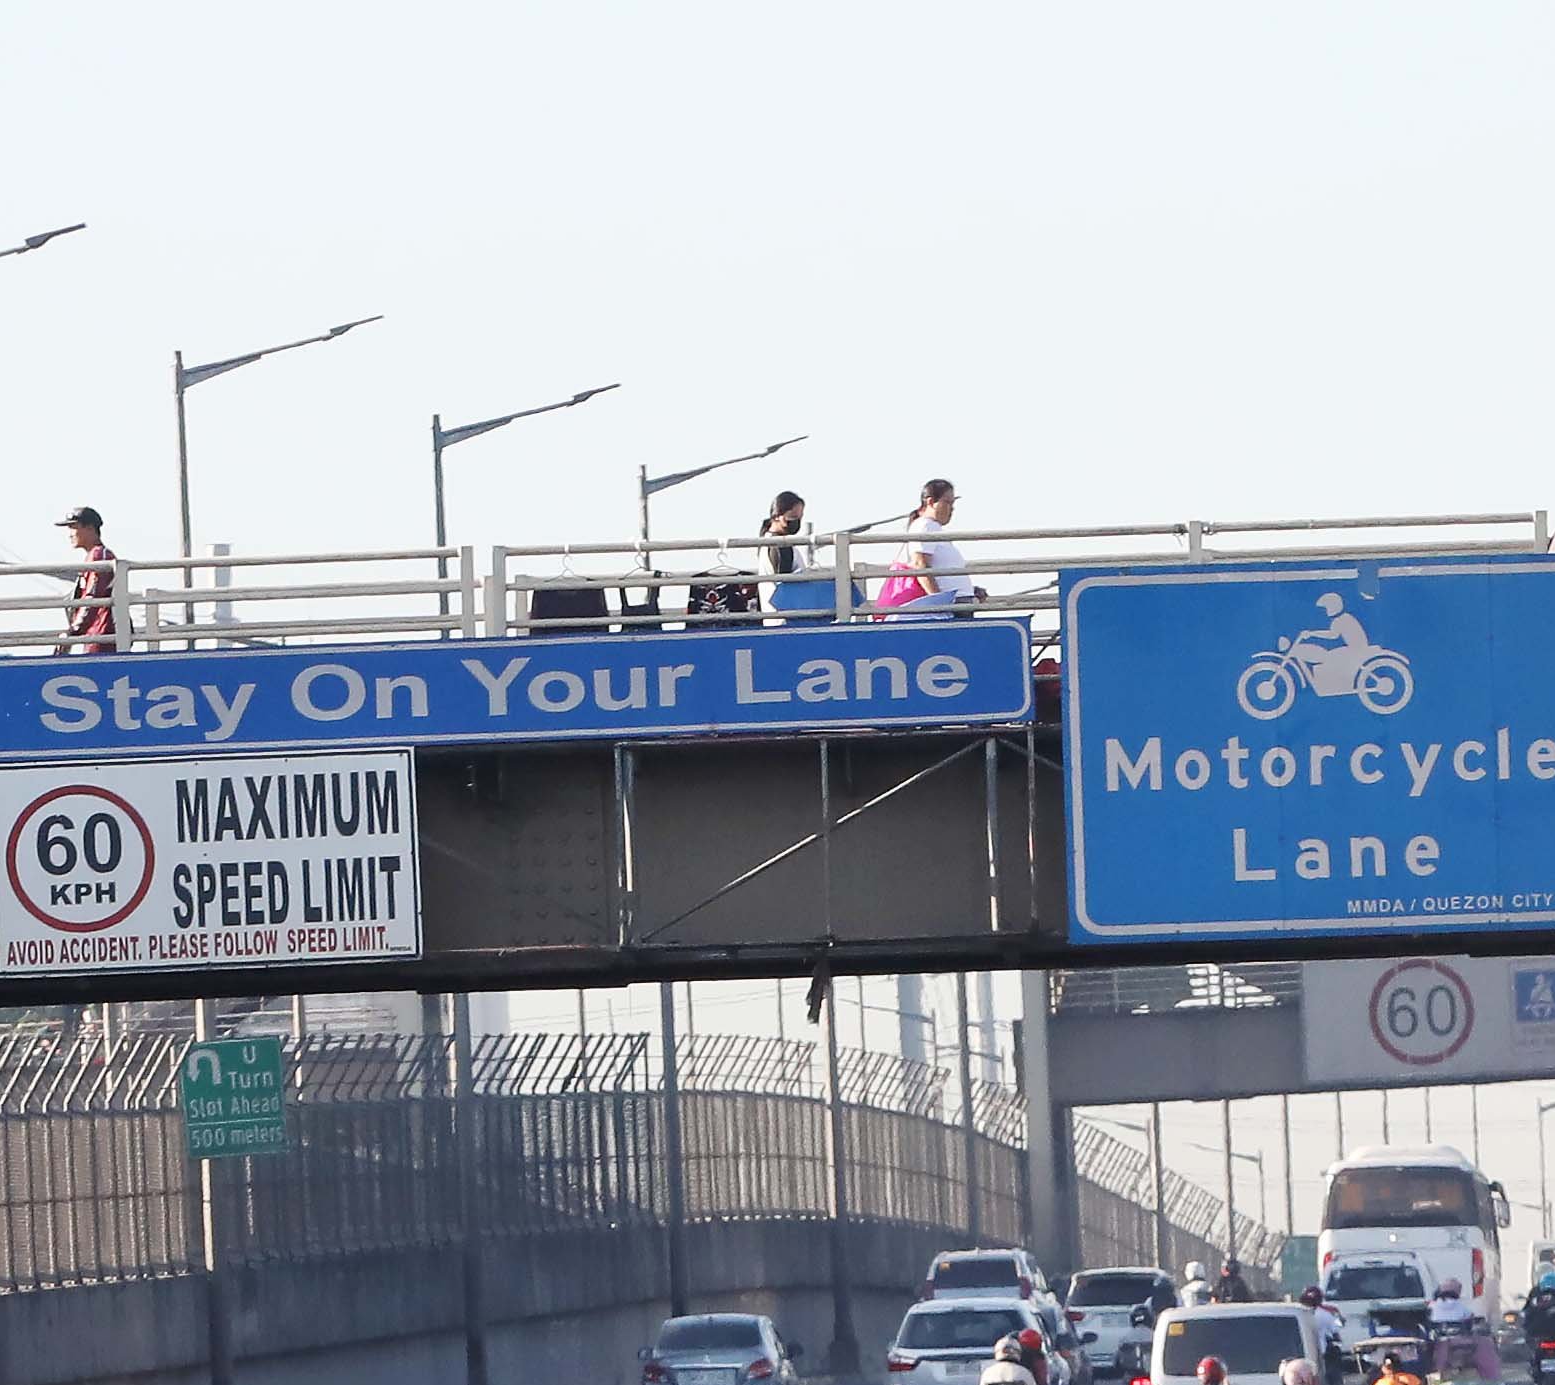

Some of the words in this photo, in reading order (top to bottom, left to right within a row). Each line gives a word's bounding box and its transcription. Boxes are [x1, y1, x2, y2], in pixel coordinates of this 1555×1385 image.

[40, 674, 254, 744] Stay
[292, 663, 427, 722] On
[461, 655, 694, 718] Your
[736, 646, 971, 705] Lane
[176, 769, 400, 843] MAXIMUM
[36, 811, 123, 876] 60
[1233, 829, 1441, 882] Lane
[50, 882, 117, 906] KPH
[173, 861, 289, 929] SPEED
[302, 855, 401, 923] LIMIT
[1347, 899, 1405, 914] MMDA
[1422, 895, 1504, 913] QUEZON
[1511, 893, 1554, 908] CITY
[7, 939, 54, 966] AVOID
[59, 936, 143, 964] ACCIDENT.
[149, 932, 209, 960] PLEASE
[214, 929, 278, 957] FOLLOW
[287, 927, 338, 954] SPEED
[343, 925, 390, 952] LIMIT.
[1385, 984, 1458, 1039] 60
[243, 1046, 256, 1064] U
[228, 1071, 273, 1089] Turn
[189, 1097, 222, 1118] Slot
[231, 1094, 279, 1114] Ahead
[192, 1129, 225, 1148] 500
